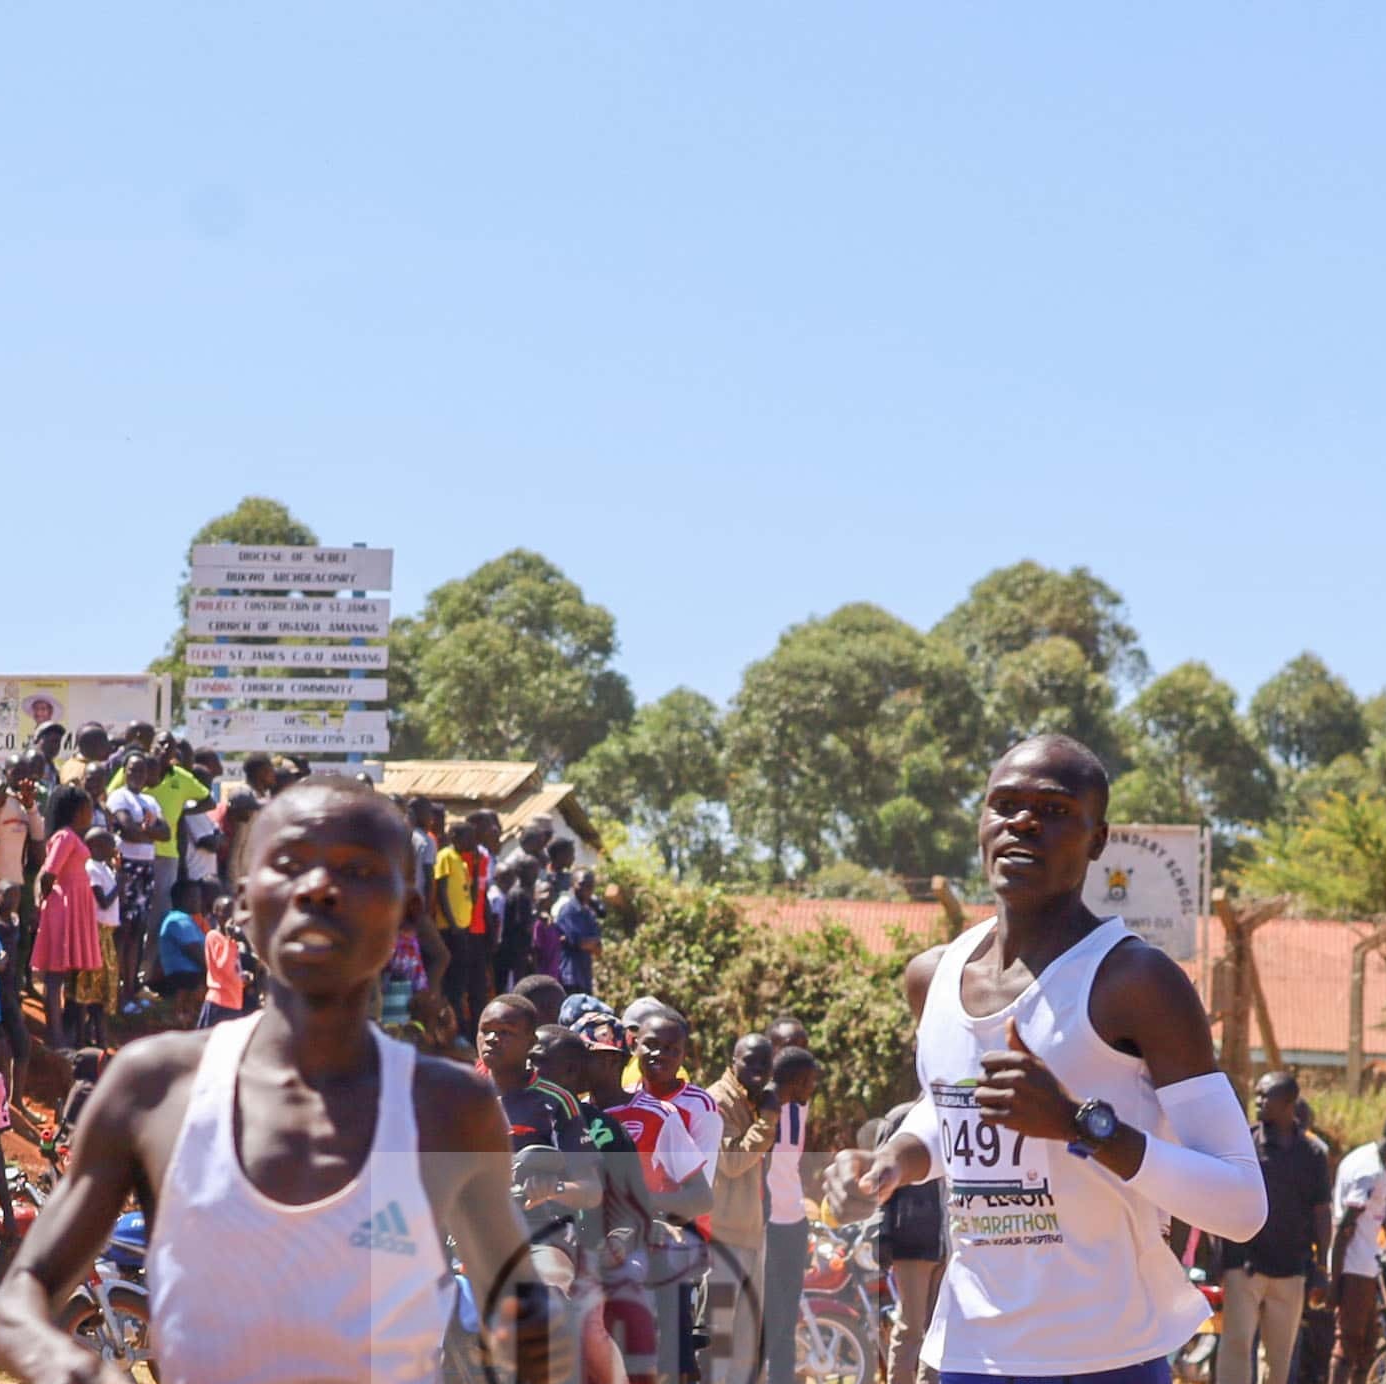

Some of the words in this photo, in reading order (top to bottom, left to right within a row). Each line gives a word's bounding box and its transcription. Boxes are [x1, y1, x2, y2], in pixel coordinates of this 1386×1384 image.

[238, 551, 283, 563] DIOCESE
[291, 551, 304, 563] OF
[208, 620, 251, 632] CHURCH
[257, 620, 271, 632] OF
[278, 621, 321, 633] UGANDA
[250, 650, 286, 662] JAMES
[241, 682, 285, 694] CHURCH
[290, 681, 355, 694] COMMUNITY
